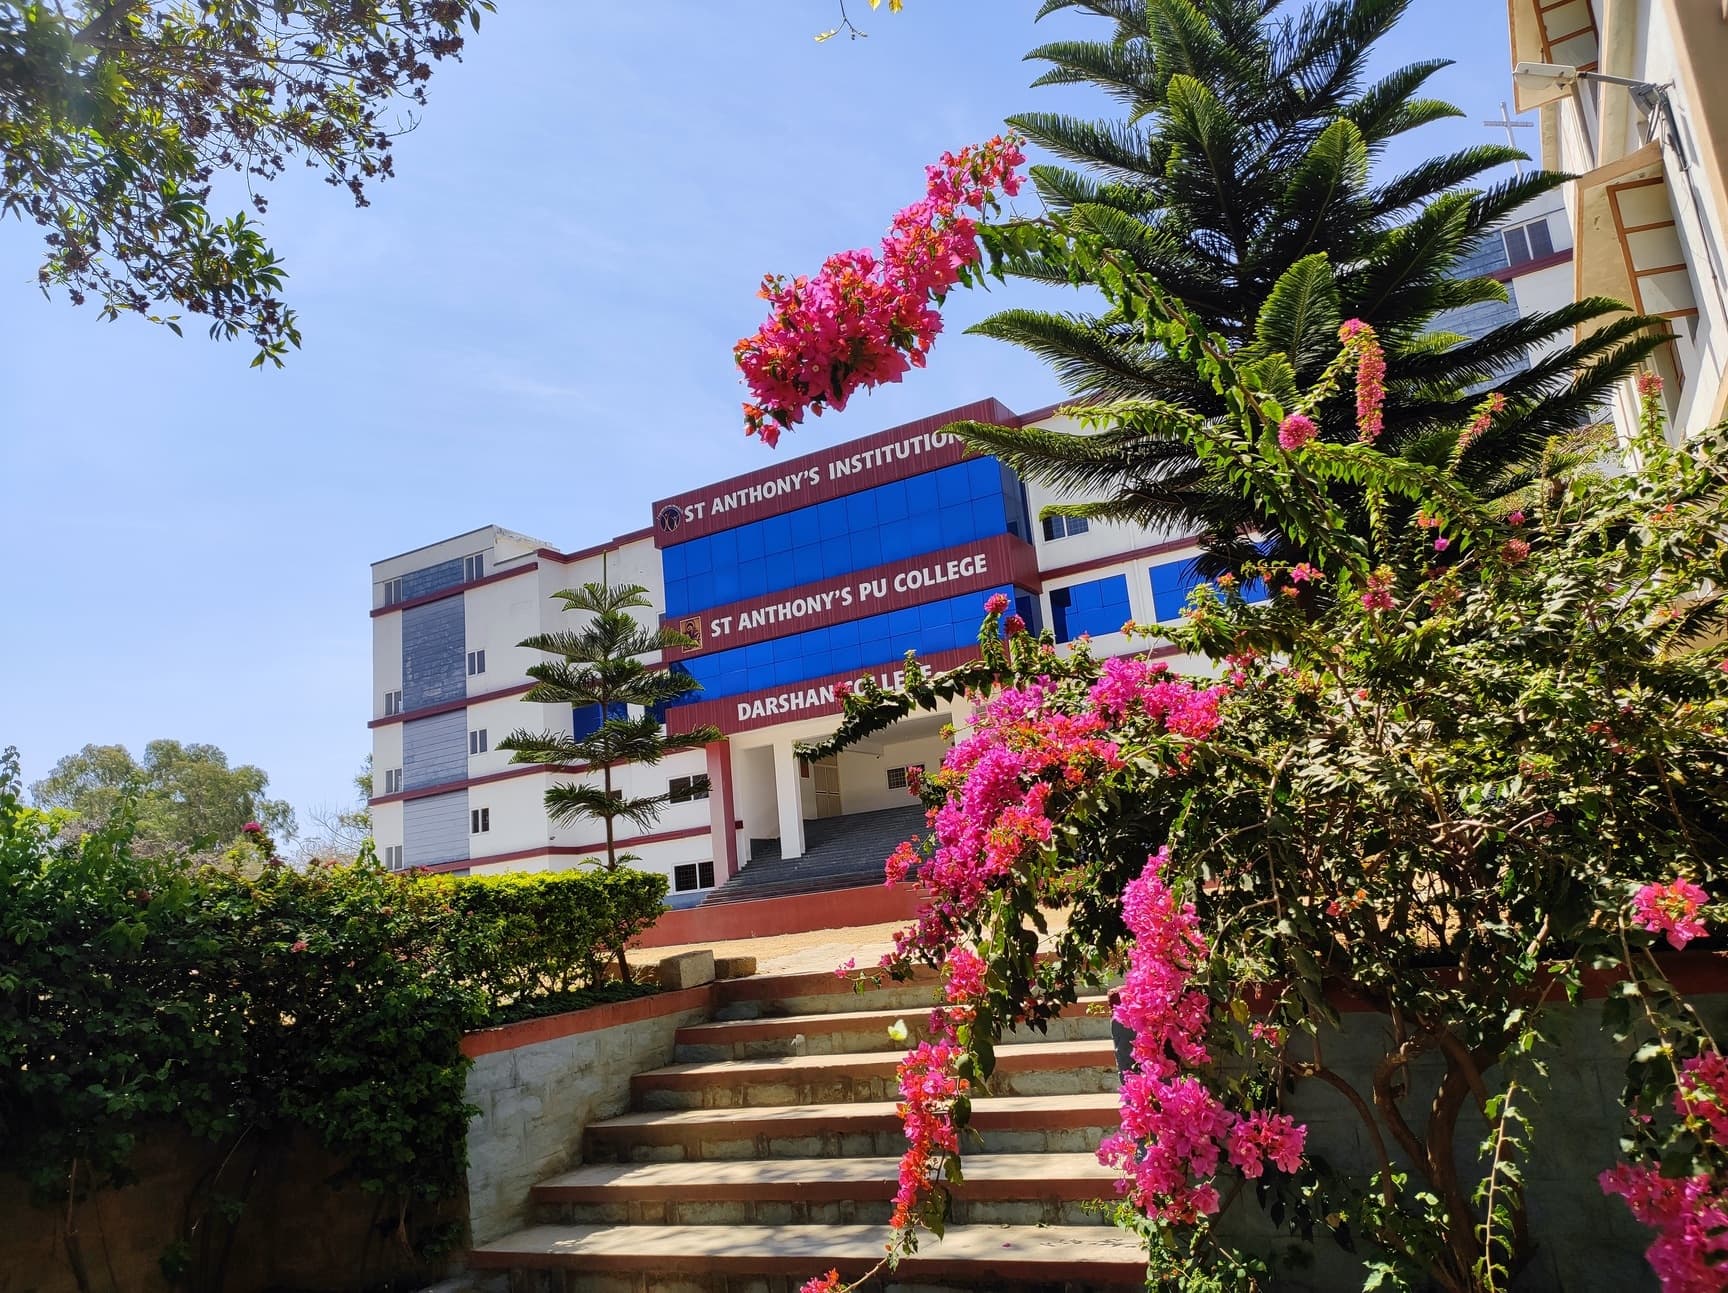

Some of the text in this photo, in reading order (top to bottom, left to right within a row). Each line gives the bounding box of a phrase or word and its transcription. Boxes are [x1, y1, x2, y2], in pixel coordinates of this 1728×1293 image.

[683, 501, 706, 523] ST
[711, 466, 820, 515] ANTHONY'S
[710, 553, 988, 638] ST ANTHONY'S PU COLLEGE
[737, 684, 835, 721] DARSHAN
